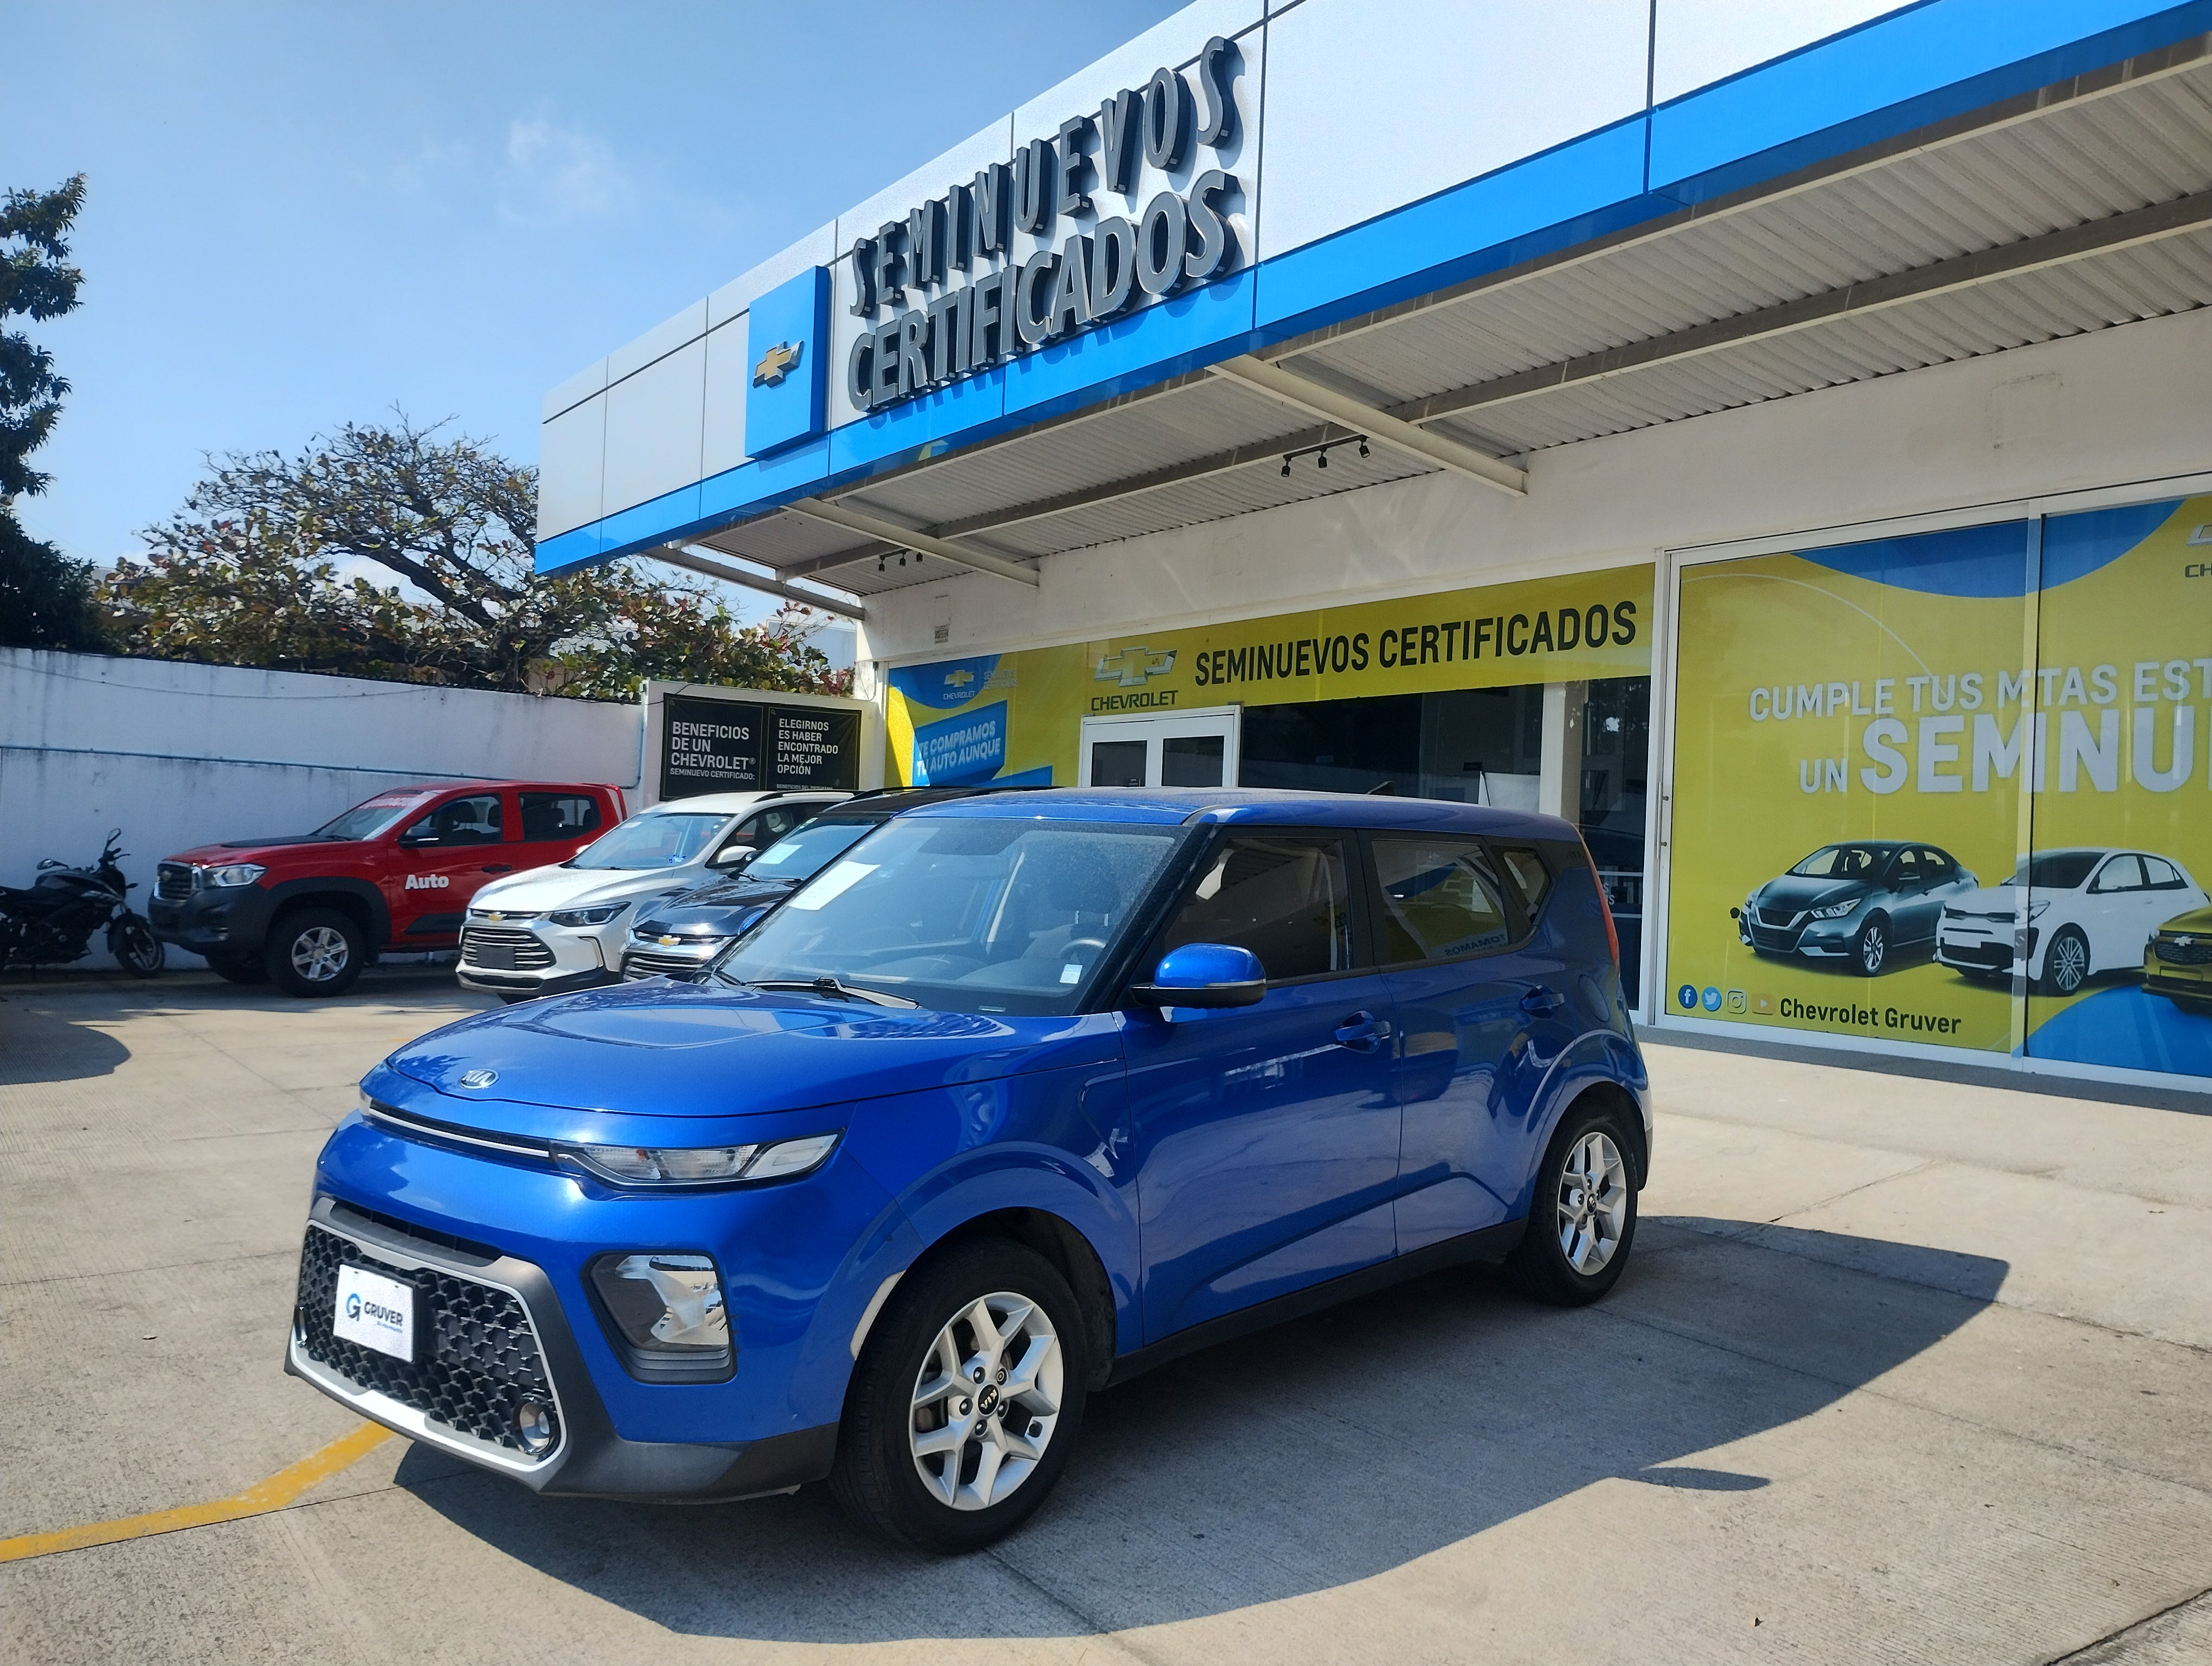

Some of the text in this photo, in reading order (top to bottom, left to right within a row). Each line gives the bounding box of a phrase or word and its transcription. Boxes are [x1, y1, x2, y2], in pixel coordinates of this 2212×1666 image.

[850, 35, 1237, 316] SEMINUEVOS
[848, 169, 1238, 412] CERTIFICADOS
[1195, 600, 1636, 687] SEMINUEVOS CERTIFICADOS
[943, 690, 976, 700] CHEVROLET
[1091, 690, 1179, 711] CHEVROLET
[1749, 678, 1895, 721] CUMPLE
[1906, 672, 1984, 712] TUS
[672, 721, 750, 740] BENEFICIOS
[779, 718, 829, 731] ELEGIRNOS
[672, 736, 711, 752] DE UN
[779, 730, 822, 741] ES HABER
[930, 720, 996, 752] COMPRAMOS
[778, 741, 838, 754] ENCONTRADO
[916, 738, 1001, 777] TU AUTO AUNQUE
[1799, 704, 2212, 794] UN SEMINU
[777, 753, 822, 765] LA MEJOR
[777, 763, 811, 775] OPCIÓN
[670, 768, 755, 780] SEMINUEVO CERTIFICADO:
[405, 874, 449, 890] Auto
[1780, 998, 1962, 1034] Chevrolet Gruver
[364, 1301, 403, 1327] GRUVER
